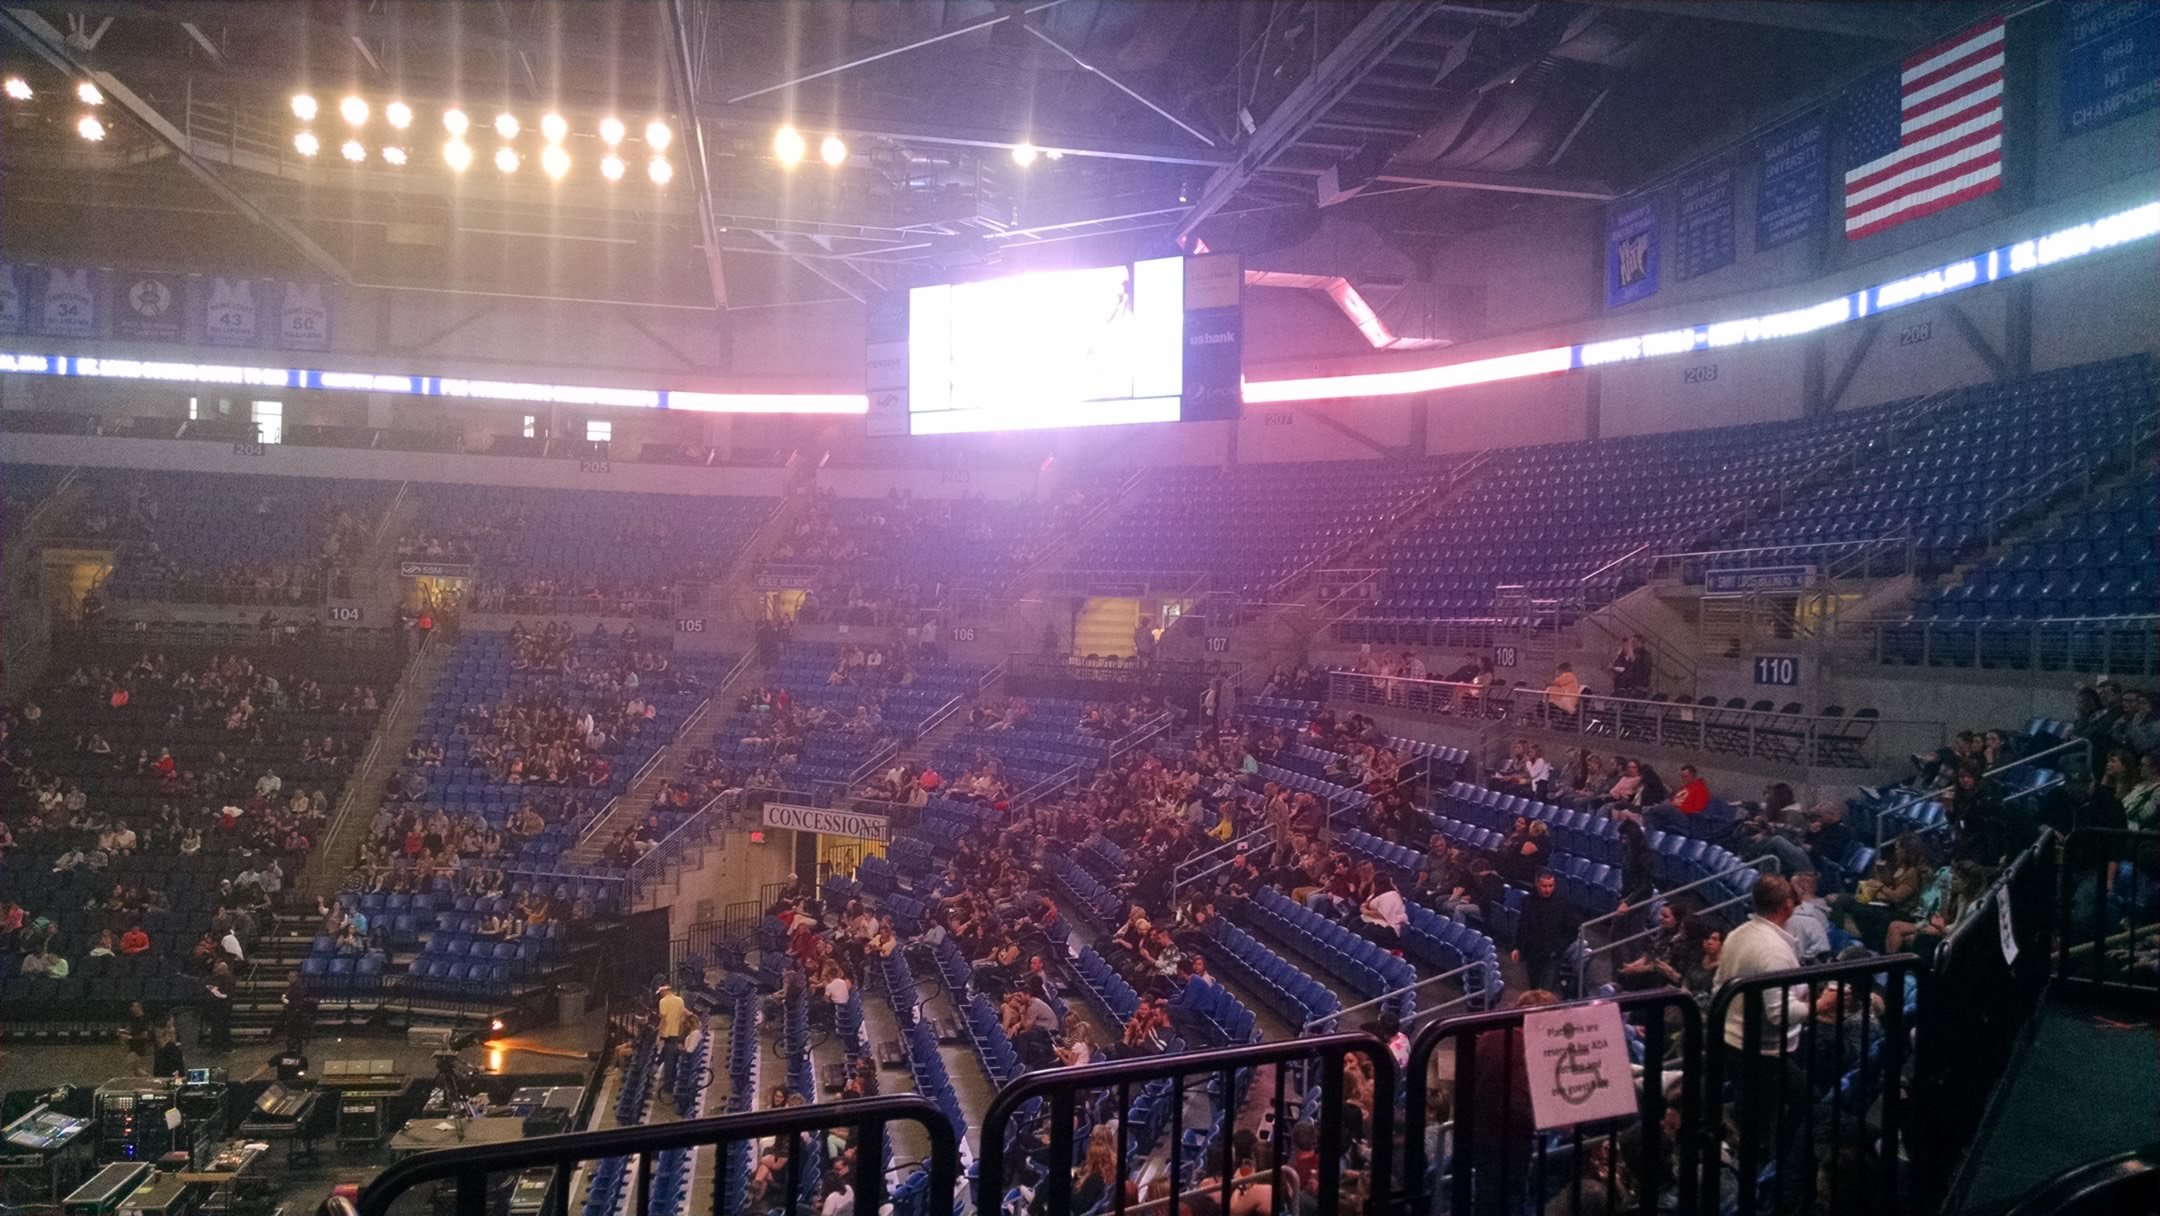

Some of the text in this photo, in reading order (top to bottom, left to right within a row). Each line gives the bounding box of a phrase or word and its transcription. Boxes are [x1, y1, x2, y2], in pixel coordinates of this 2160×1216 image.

[219, 313, 242, 327] 43
[1686, 366, 1715, 383] 208
[235, 444, 262, 455] 204
[332, 607, 359, 620] 104
[680, 620, 703, 632] 105
[953, 628, 974, 641] 106
[1208, 637, 1227, 651] 107
[1496, 647, 1515, 666] 108
[1759, 658, 1793, 684] 110
[769, 806, 881, 838] CONCESSIONS
[1591, 1039, 1608, 1050] ADA
